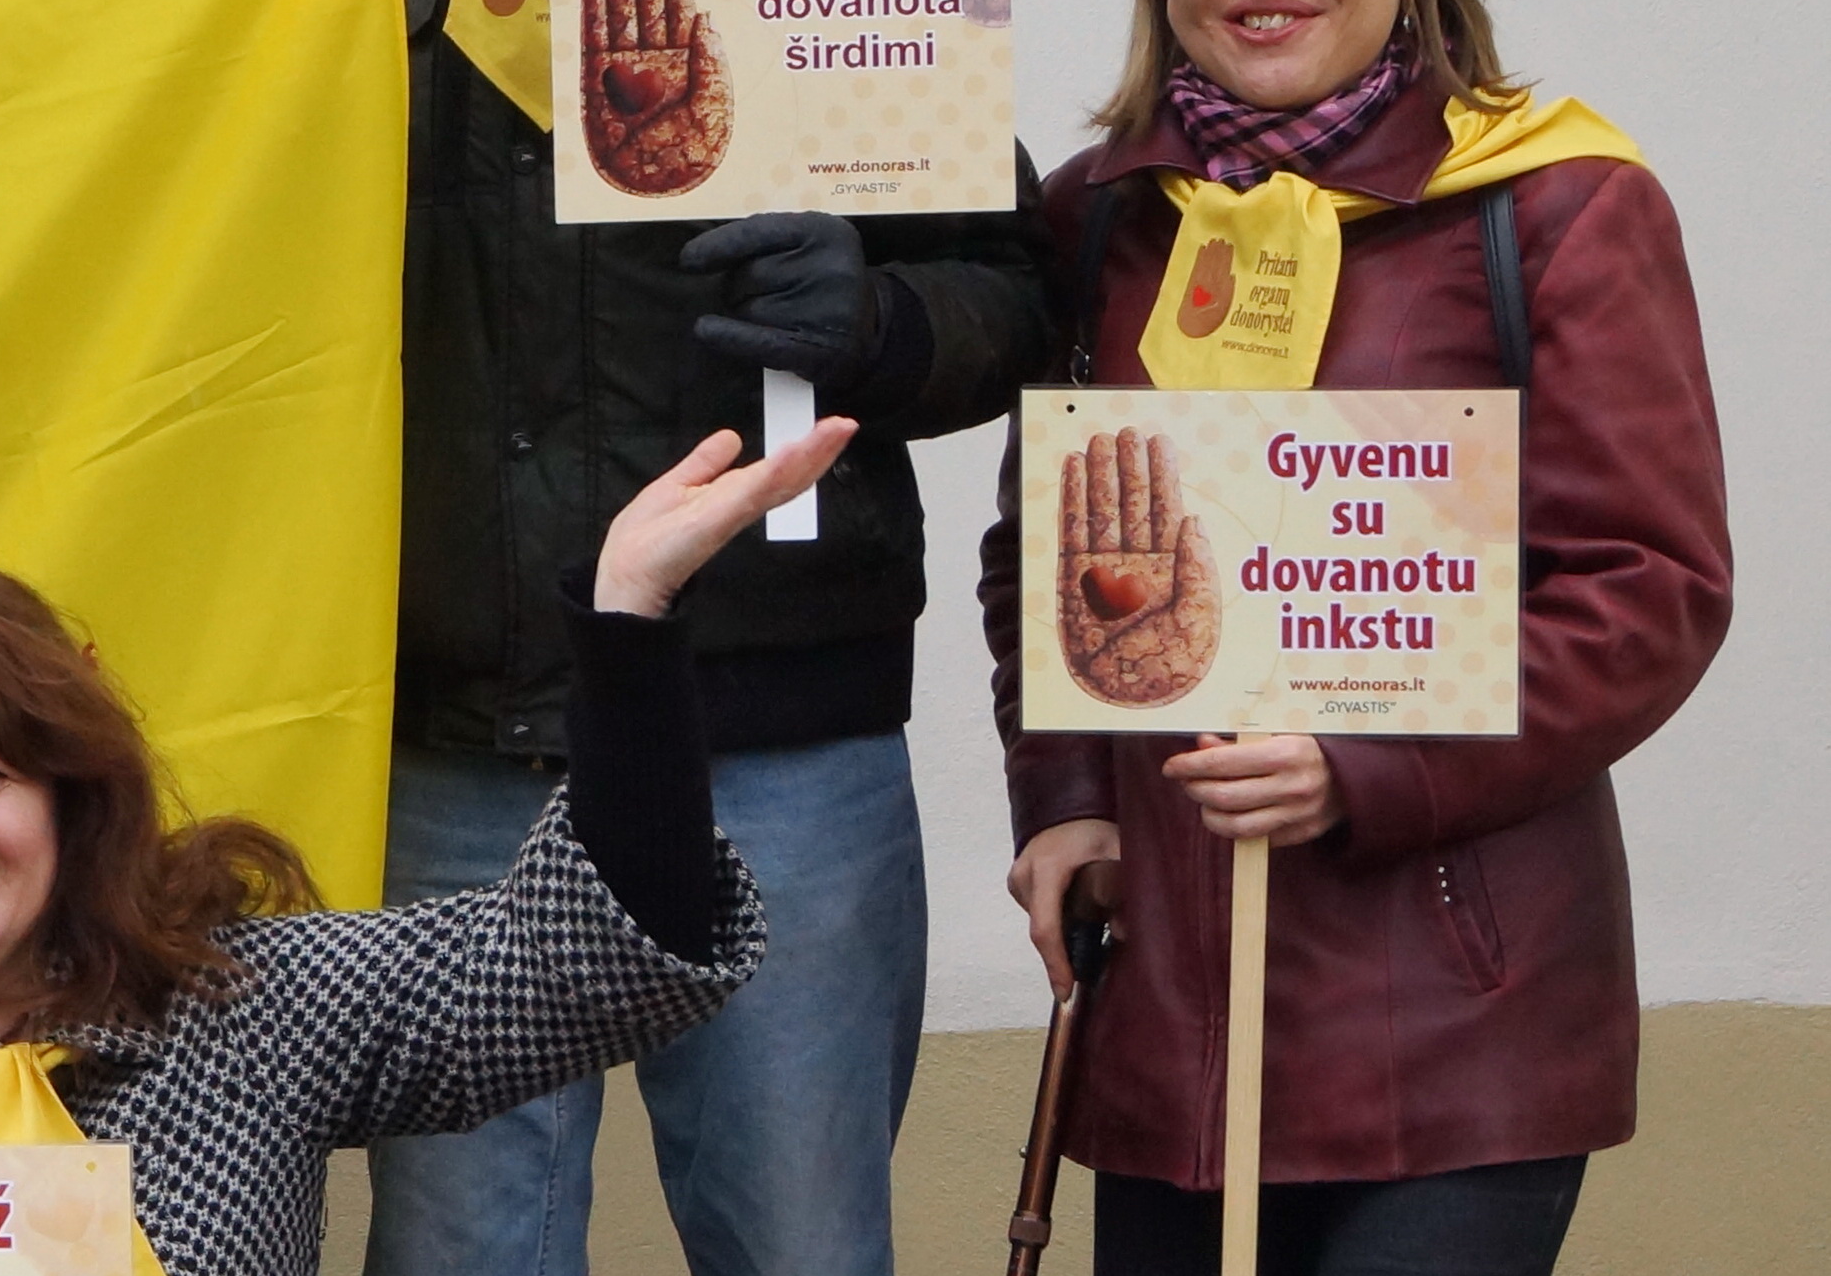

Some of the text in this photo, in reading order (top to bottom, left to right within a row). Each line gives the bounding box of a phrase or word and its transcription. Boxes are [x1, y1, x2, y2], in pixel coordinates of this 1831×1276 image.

[787, 33, 933, 69] širdimi
[808, 158, 930, 173] www.donoras.lt
[1268, 433, 1448, 490] Gyvenu
[1333, 502, 1383, 535] su
[1242, 547, 1474, 592] dovanotu
[1282, 603, 1432, 649] inkstu
[1290, 677, 1425, 691] www.donoras.lt
